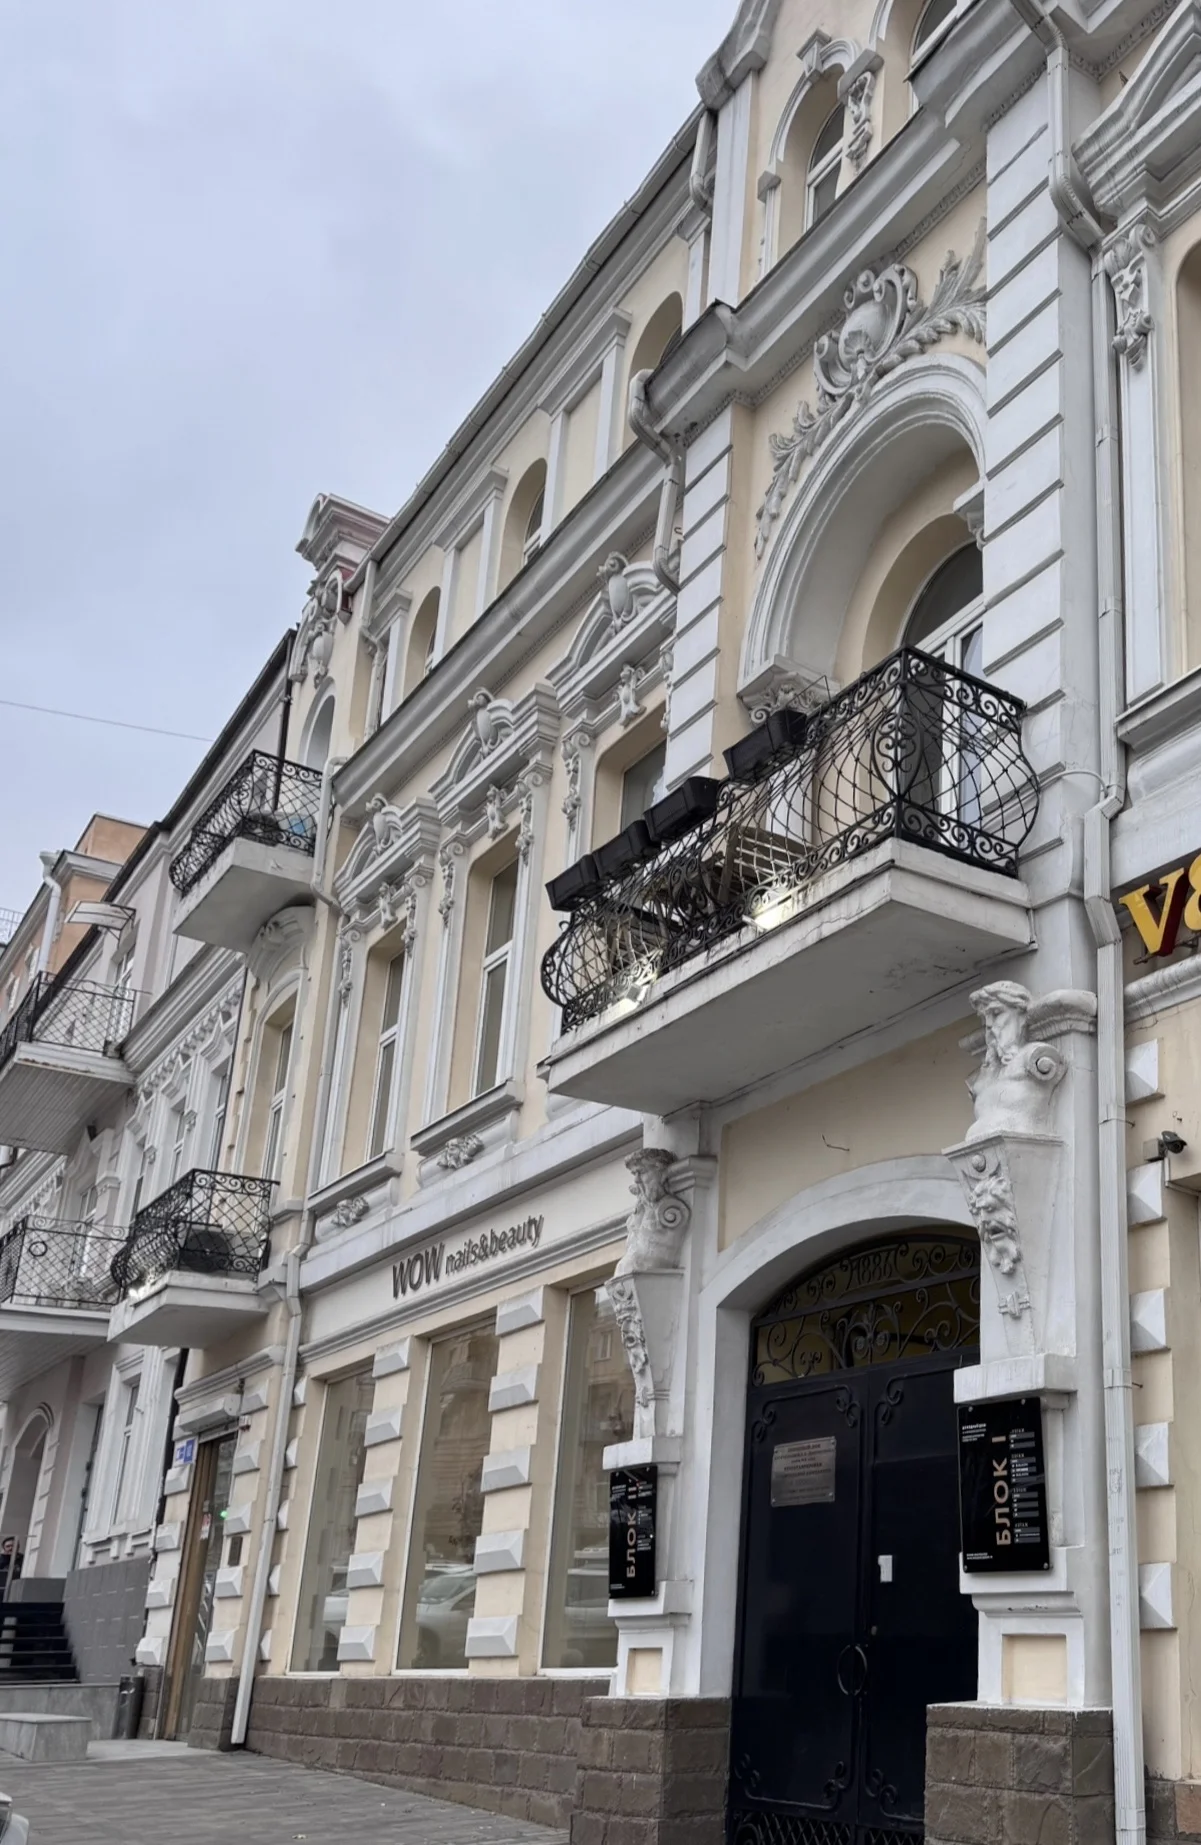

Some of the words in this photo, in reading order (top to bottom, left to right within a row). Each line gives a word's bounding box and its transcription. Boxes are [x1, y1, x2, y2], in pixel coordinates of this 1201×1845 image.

[393, 1242, 445, 1299] WOW
[446, 1214, 544, 1276] nails&beauty
[992, 1457, 1011, 1545] БЛОК
[627, 1510, 636, 1578] БЛОК
